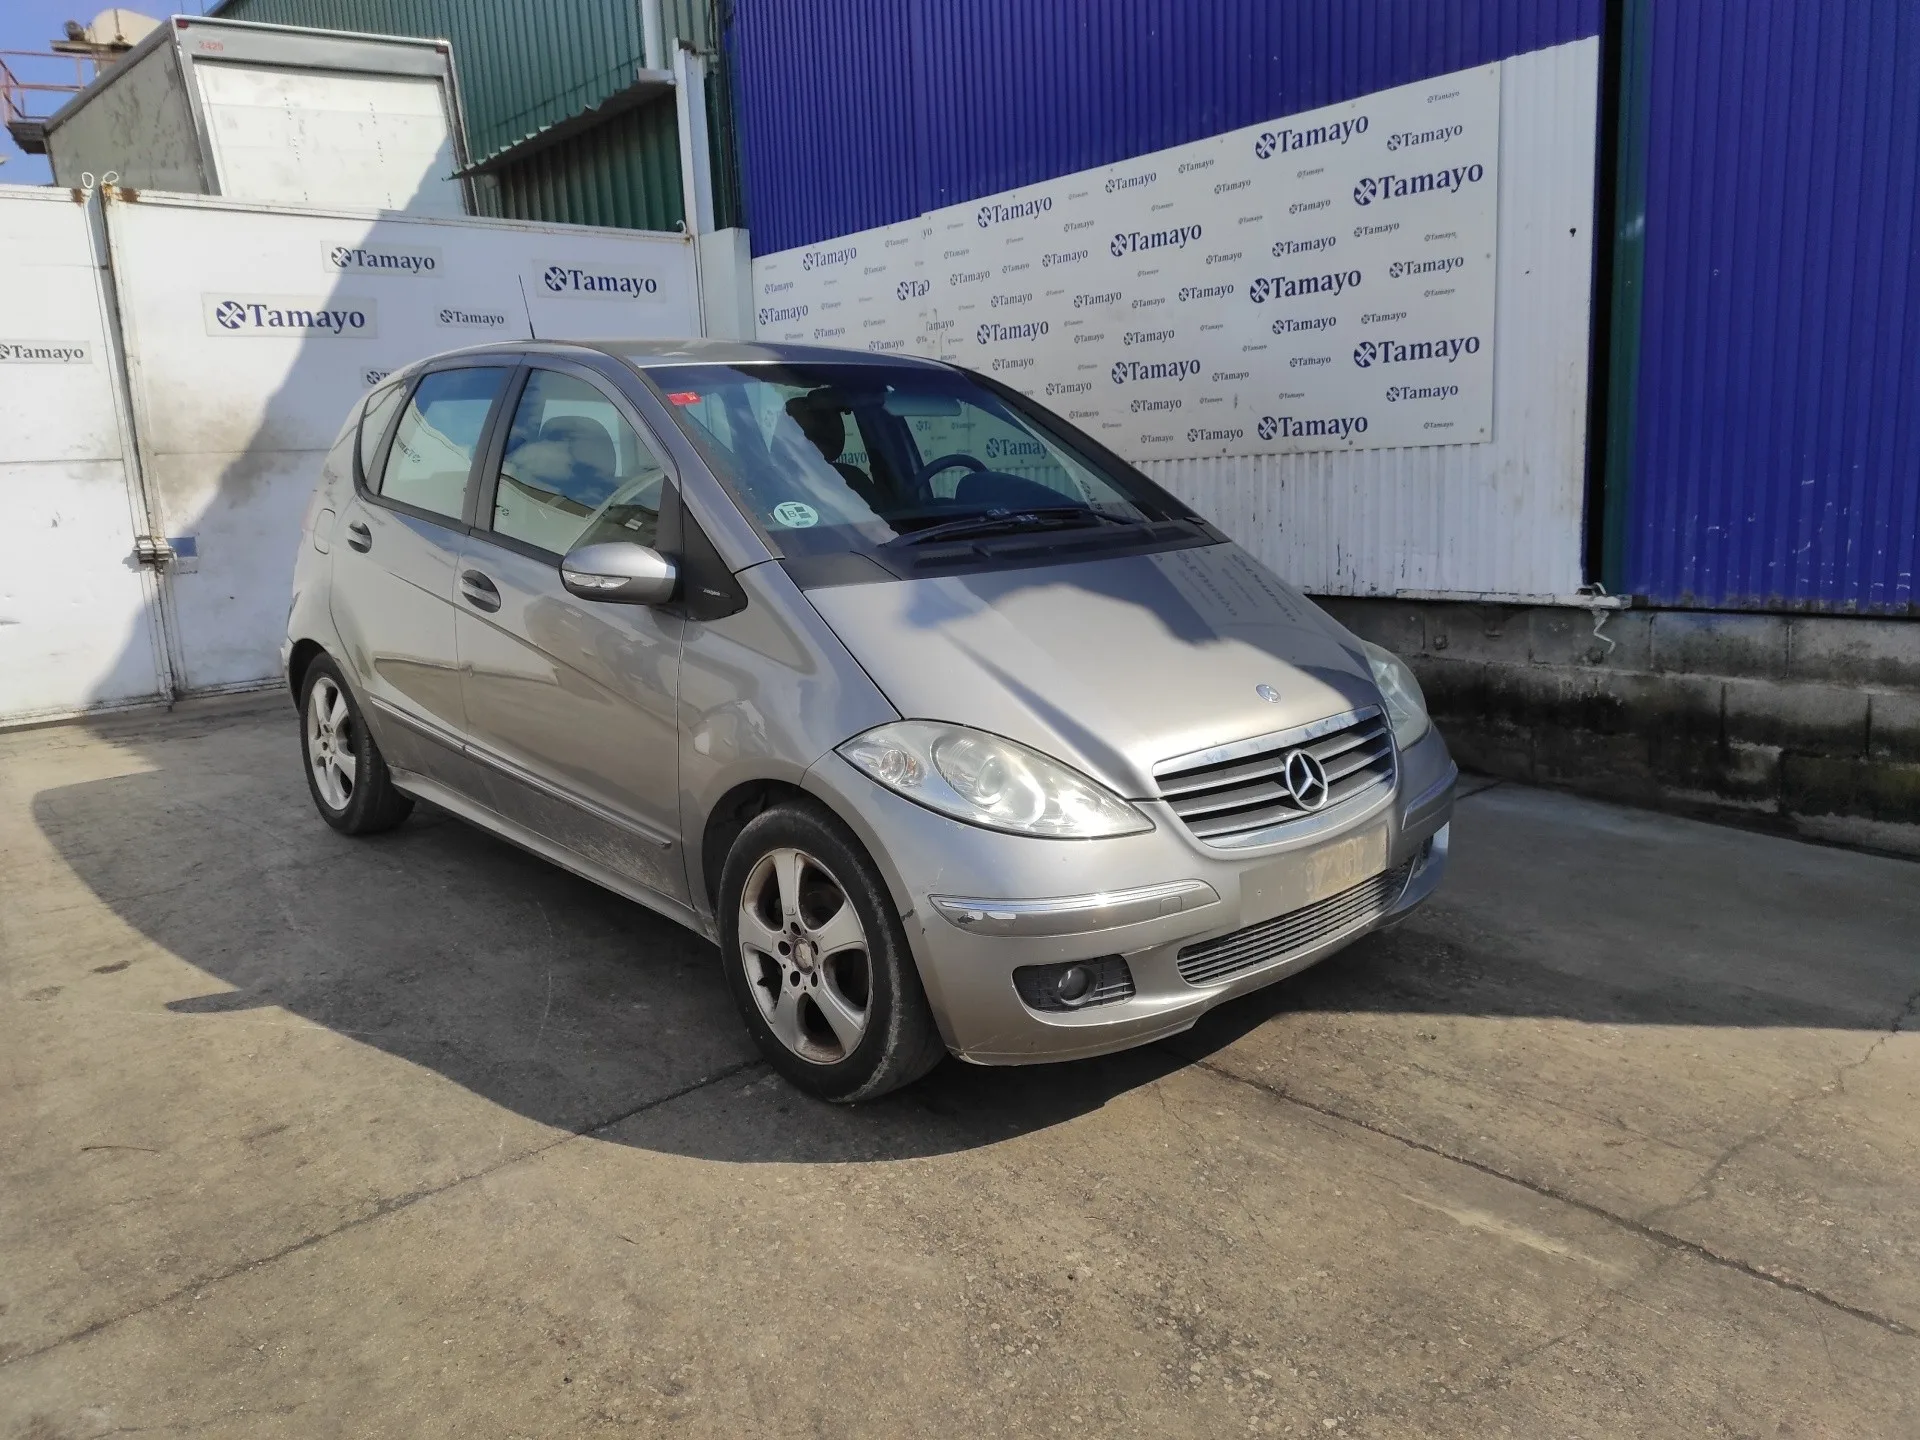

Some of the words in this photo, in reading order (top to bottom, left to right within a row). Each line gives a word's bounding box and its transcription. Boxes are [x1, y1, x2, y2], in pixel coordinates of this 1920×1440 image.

[1434, 91, 1460, 102] Tamayo
[1278, 116, 1368, 154] Tamayo
[1402, 124, 1463, 148] Tamayo
[1186, 158, 1214, 172] Tamayo
[1115, 172, 1156, 190] Tamayo
[1222, 179, 1251, 192] Tamayo
[1378, 164, 1484, 200] Tamayo
[992, 197, 1052, 223] Tamayo
[1298, 200, 1330, 212] Tamayo
[1070, 220, 1094, 230] Tamayo
[1363, 223, 1400, 236] Tamayo
[1128, 224, 1202, 252] Tamayo
[1285, 236, 1336, 255] Tamayo
[352, 249, 435, 274] Tamayo
[814, 248, 857, 267] Tamayo
[1050, 250, 1088, 265] Tamayo
[1213, 252, 1242, 263] Tamayo
[1008, 263, 1030, 272] Tamayo
[1404, 256, 1464, 276] Tamayo
[568, 269, 656, 298] Tamayo
[959, 270, 990, 284] Tamayo
[770, 281, 794, 292] Tamayo
[1271, 270, 1362, 299] Tamayo
[1083, 292, 1122, 306] Tamayo
[1190, 284, 1234, 300] Tamayo
[1000, 293, 1032, 306] Tamayo
[1139, 298, 1166, 308] Tamayo
[247, 304, 364, 334] Tamayo
[453, 311, 504, 326] Tamayo
[768, 304, 808, 323] Tamayo
[1370, 312, 1407, 323] Tamayo
[991, 321, 1048, 341] Tamayo
[1284, 316, 1336, 332] Tamayo
[820, 327, 846, 338] Tamayo
[1080, 334, 1104, 342] Tamayo
[1134, 330, 1174, 344] Tamayo
[875, 339, 904, 350] Tamayo
[1378, 336, 1480, 363] Tamayo
[10, 344, 84, 362] Tamayo
[1000, 358, 1034, 370] Tamayo
[1297, 356, 1331, 366] Tamayo
[1128, 359, 1200, 382] Tamayo
[1219, 371, 1250, 381] Tamayo
[1054, 382, 1092, 394] Tamayo
[1400, 385, 1458, 400] Tamayo
[1140, 400, 1182, 412] Tamayo
[1076, 410, 1100, 418] Tamayo
[1198, 426, 1244, 441] Tamayo
[1278, 416, 1368, 440] Tamayo
[1148, 435, 1174, 443] Tamayo
